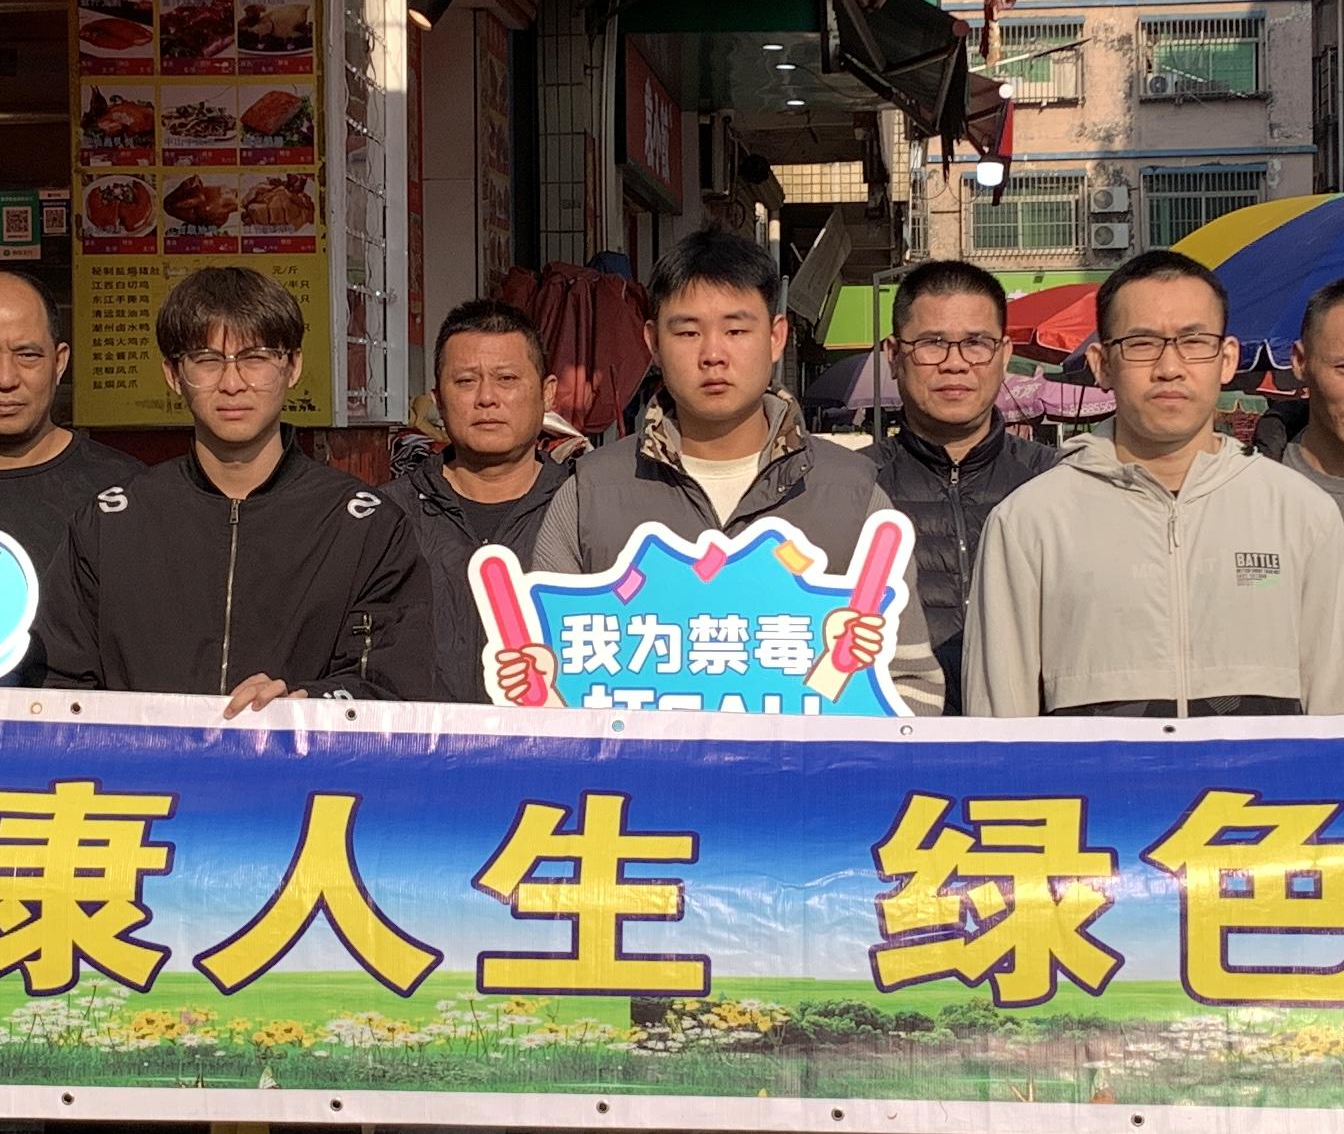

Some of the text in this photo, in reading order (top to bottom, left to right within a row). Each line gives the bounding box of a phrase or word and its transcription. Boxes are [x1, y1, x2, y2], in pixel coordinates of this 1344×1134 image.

[1236, 553, 1279, 568] BATTLE
[560, 613, 815, 676] 我为禁毒
